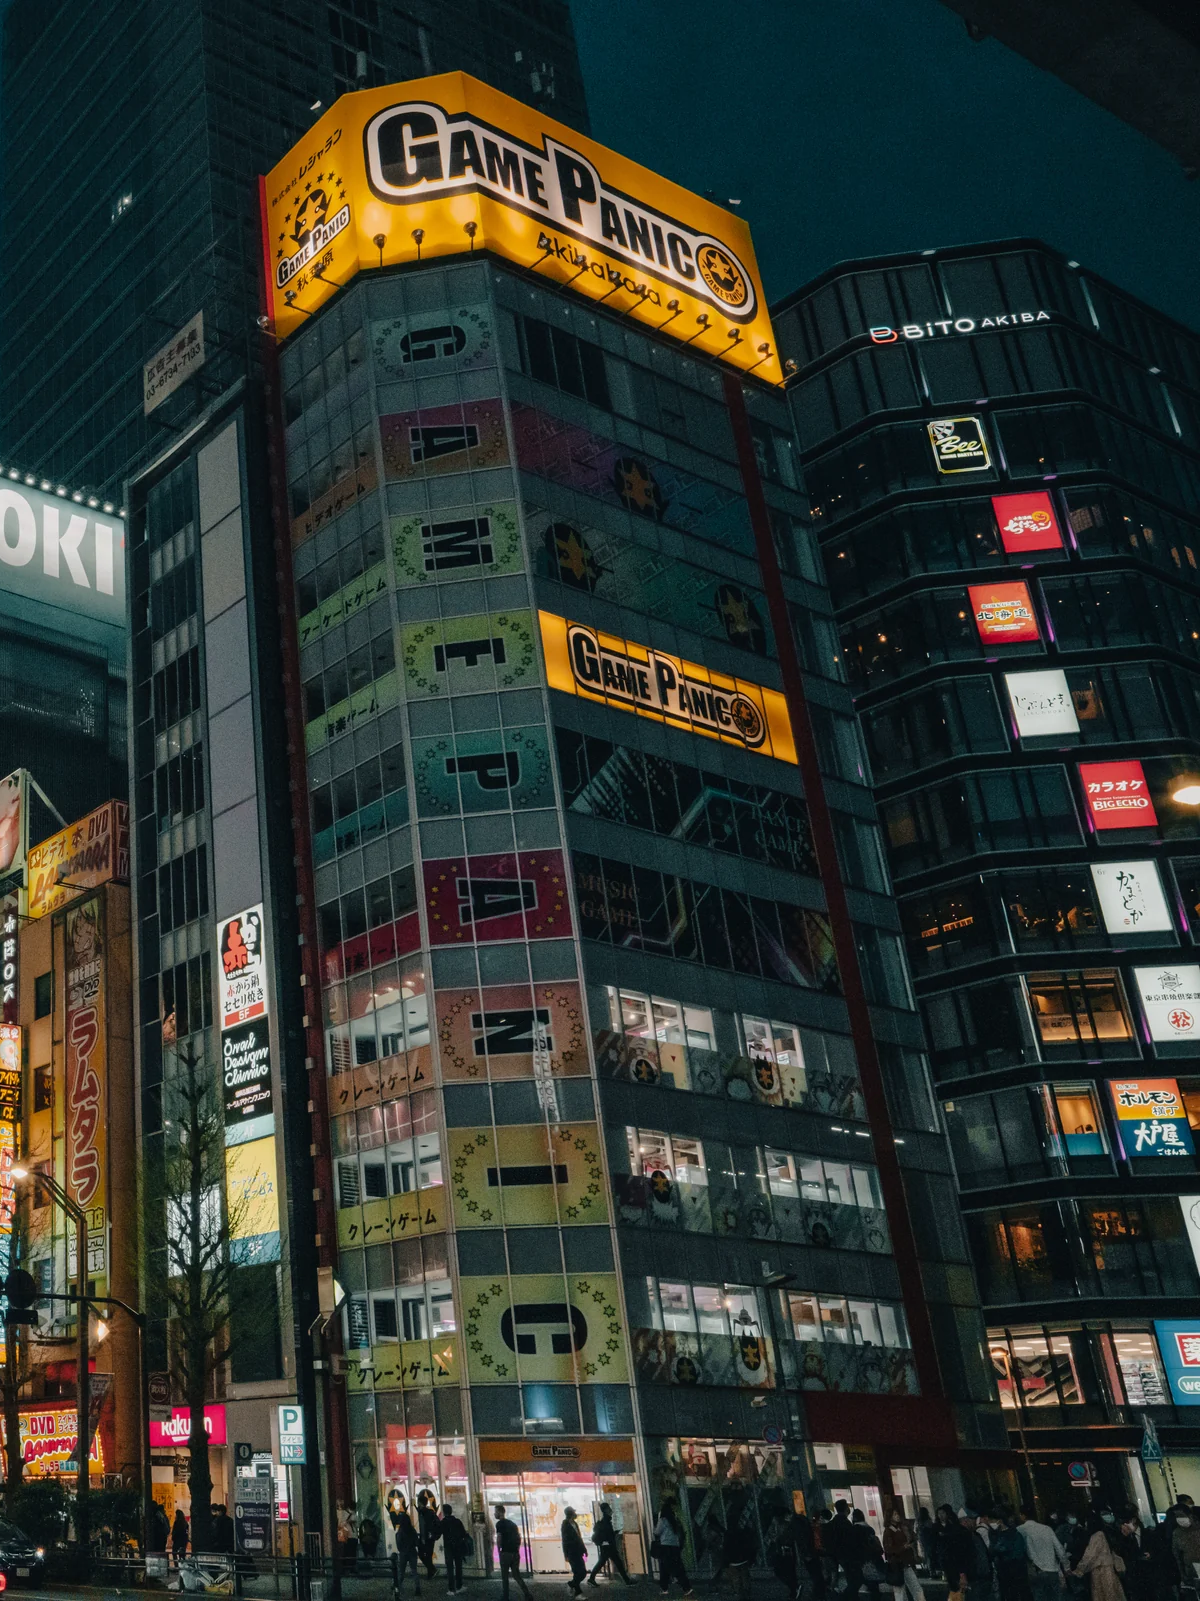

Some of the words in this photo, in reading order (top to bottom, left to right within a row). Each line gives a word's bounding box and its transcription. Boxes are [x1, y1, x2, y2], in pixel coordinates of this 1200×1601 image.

[377, 110, 549, 210] GAME
[554, 142, 694, 281] PANIC
[278, 248, 311, 285] GAME
[311, 210, 347, 252] PANIC
[981, 311, 1051, 329] AKIBA
[935, 435, 982, 453] Bee
[977, 608, 1032, 621] 北海道
[573, 633, 652, 700] GAME
[654, 658, 732, 726] PANIC
[1088, 780, 1143, 793] カラオケ
[1092, 800, 1115, 811] BIG
[1116, 798, 1149, 809] ECHO
[88, 809, 109, 842] DVD
[238, 1007, 250, 1021] 5F
[1171, 1010, 1192, 1028] 松
[225, 1047, 269, 1072] Design
[225, 1065, 269, 1087] Clinic
[338, 1066, 425, 1105] クレーンゲーム
[71, 1006, 101, 1207] ラムタラ
[1119, 1091, 1176, 1107] ホルモン
[1152, 1106, 1179, 1116] 横丁
[1134, 1120, 1185, 1152] 大戸屋
[348, 1208, 438, 1241] クレーンゲーム
[355, 1361, 451, 1386] クレーンゲーム
[30, 1415, 55, 1436] DVD
[161, 1414, 213, 1437] Rakun
[282, 1409, 299, 1432] P
[280, 1445, 294, 1458] IN
[532, 1445, 551, 1457] GAME
[551, 1445, 573, 1457] PANIC
